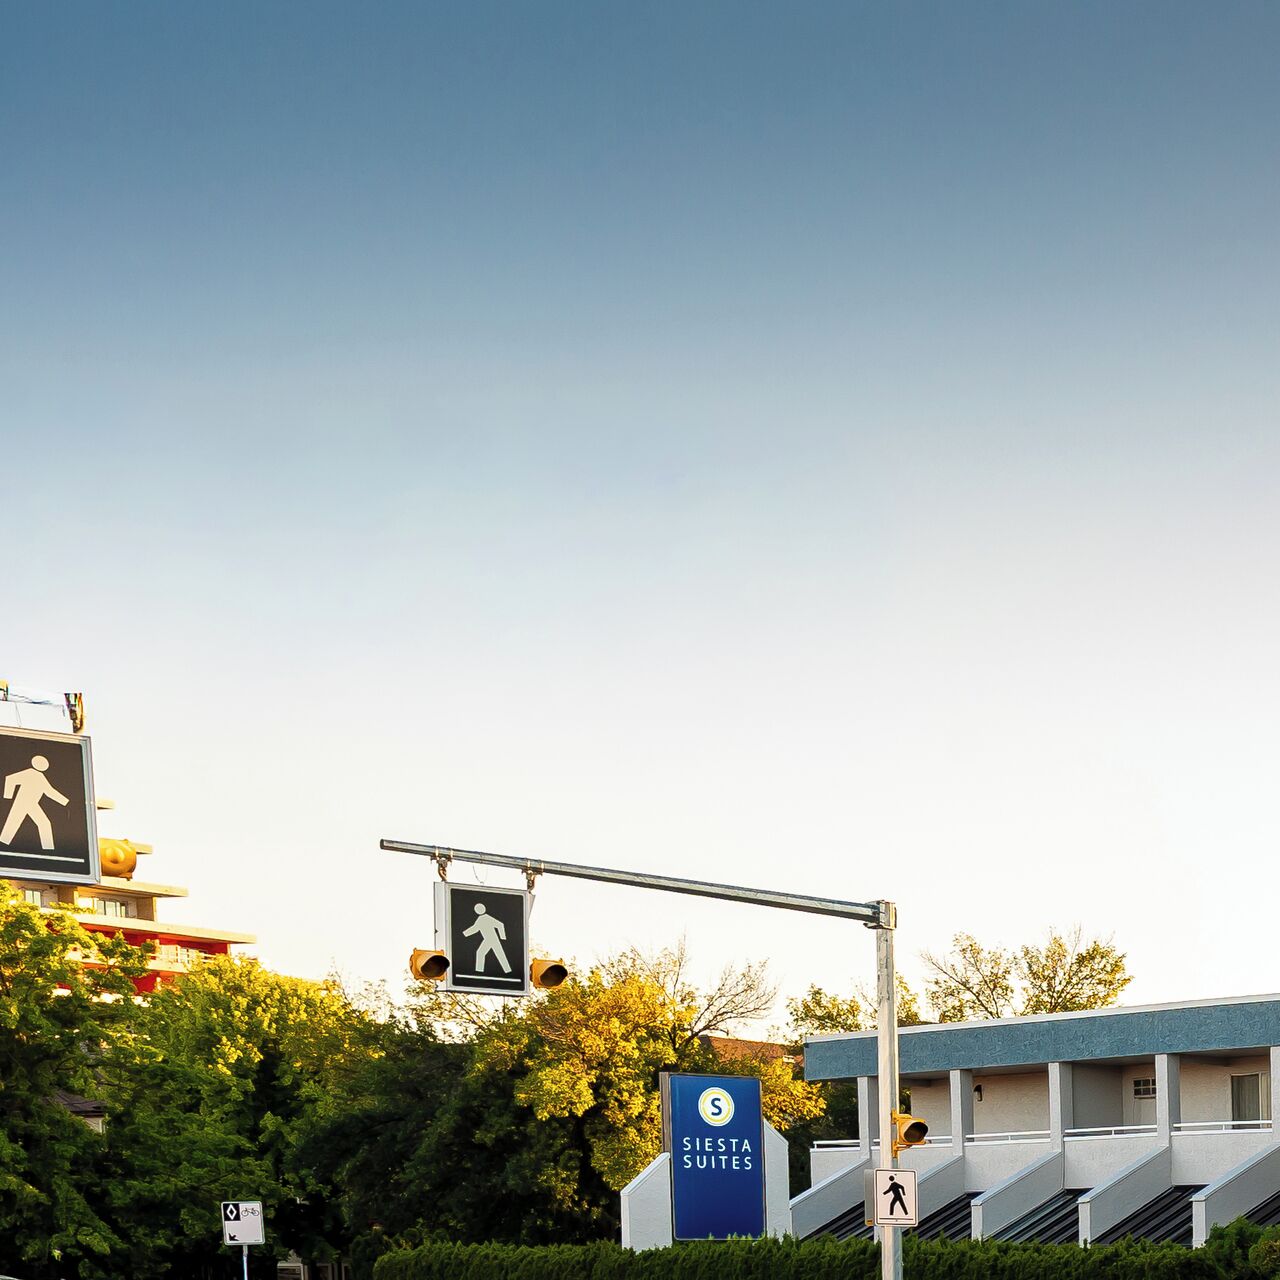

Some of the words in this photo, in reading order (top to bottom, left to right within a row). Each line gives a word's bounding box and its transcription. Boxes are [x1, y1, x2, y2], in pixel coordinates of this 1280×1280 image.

[711, 1097, 723, 1117] S
[682, 1136, 752, 1153] SIESTA
[683, 1154, 753, 1170] SUITES
